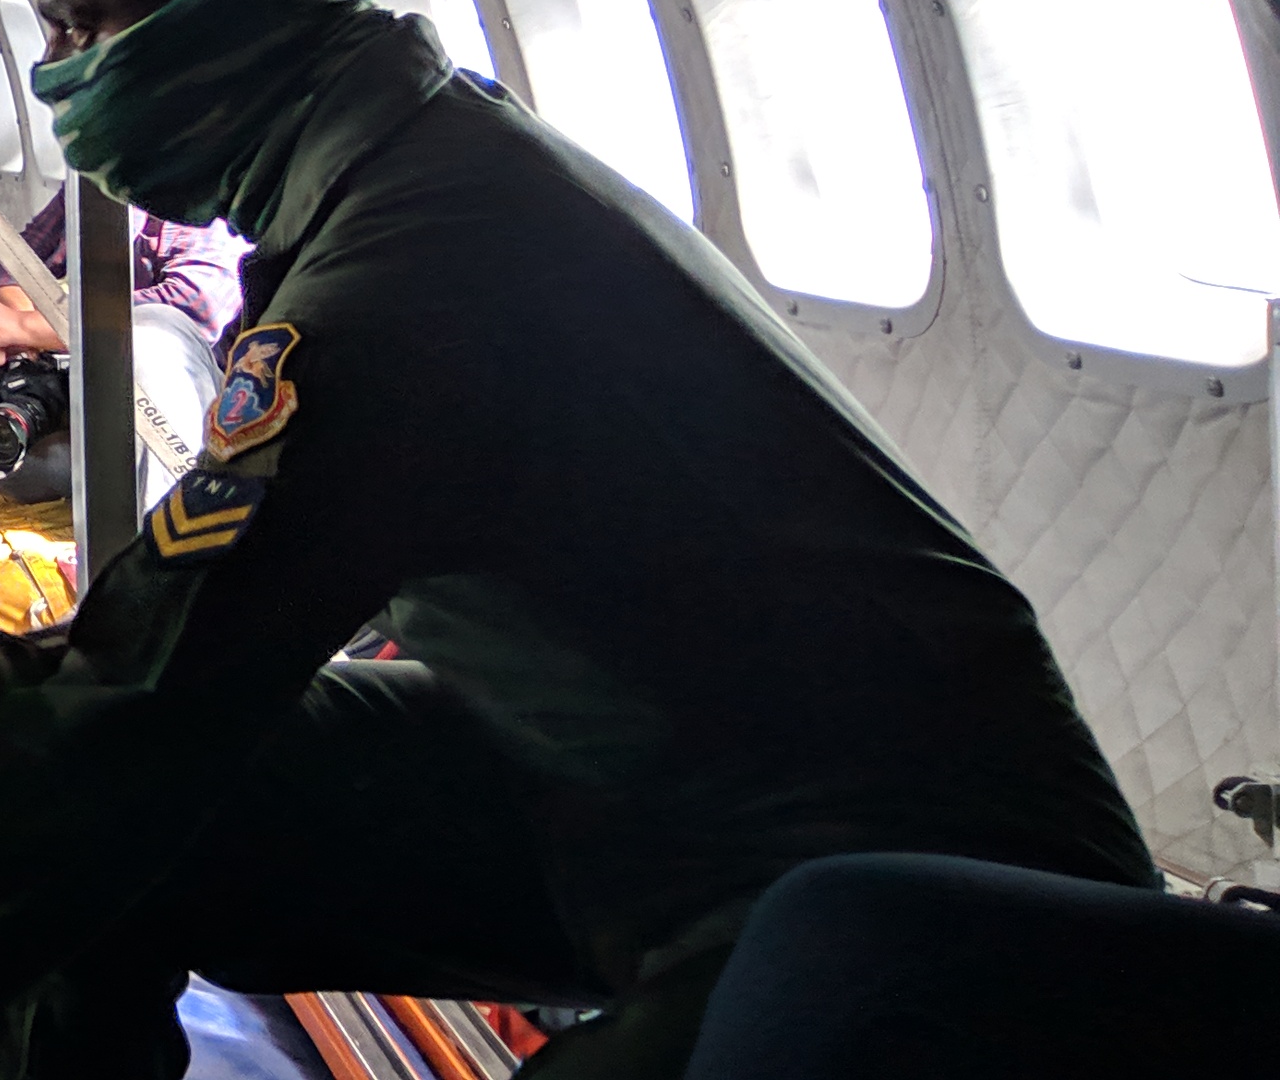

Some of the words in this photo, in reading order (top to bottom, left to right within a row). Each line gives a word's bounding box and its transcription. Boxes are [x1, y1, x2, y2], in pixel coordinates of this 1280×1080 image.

[222, 390, 248, 425] 2
[136, 397, 190, 455] CGU-1/B
[192, 476, 236, 499] TNI
